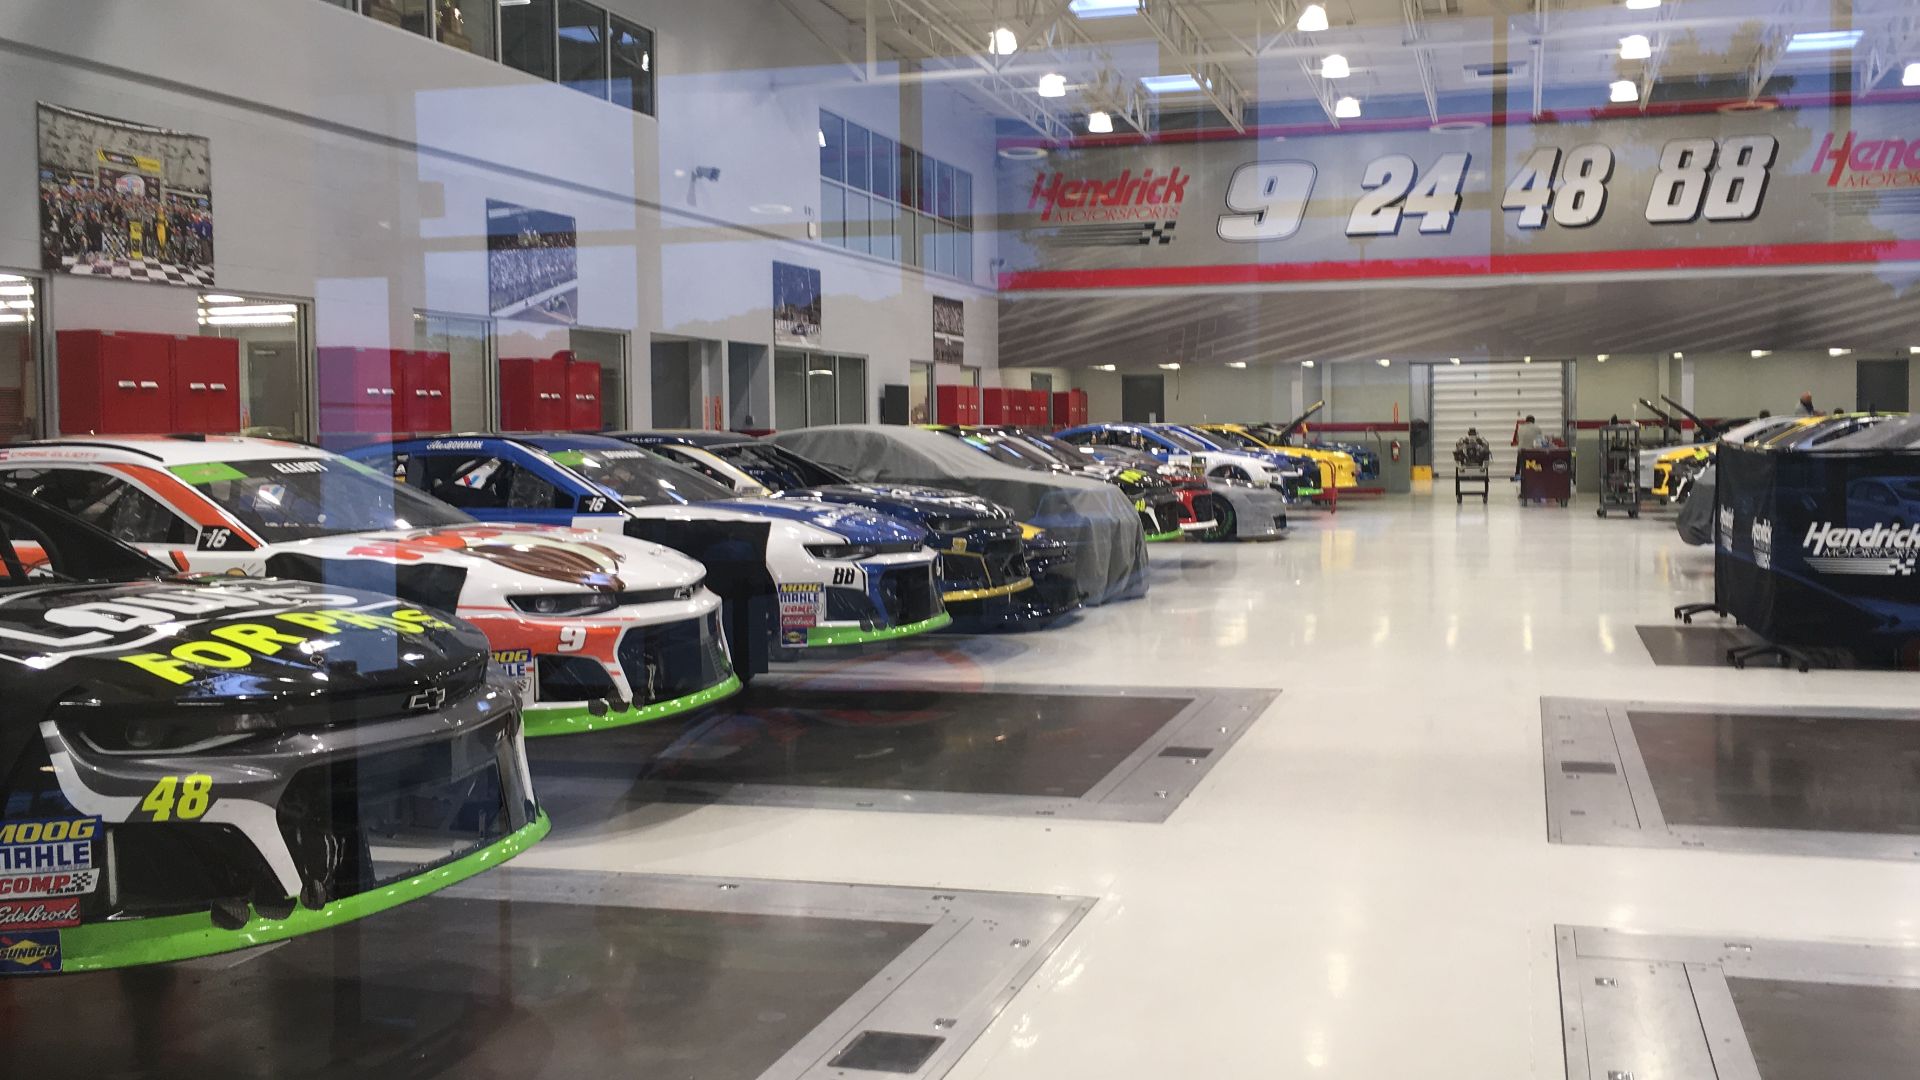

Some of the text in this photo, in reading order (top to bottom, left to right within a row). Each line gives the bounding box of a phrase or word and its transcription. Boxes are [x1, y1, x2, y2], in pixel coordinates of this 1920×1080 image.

[1027, 166, 1190, 222] Hendrick
[1216, 134, 1780, 243] 9 24 48 88
[1055, 206, 1180, 223] MOTORSPORTS
[589, 497, 606, 512] 16
[206, 529, 230, 548] 16
[1803, 521, 1920, 556] Hendrick
[1822, 547, 1918, 558] MOTORSPORTS
[833, 567, 855, 584] 88
[557, 626, 587, 652] 9
[118, 623, 307, 684] FOR
[142, 773, 212, 822] 48
[0, 874, 71, 894] COMP
[0, 903, 79, 925] Edelbrock
